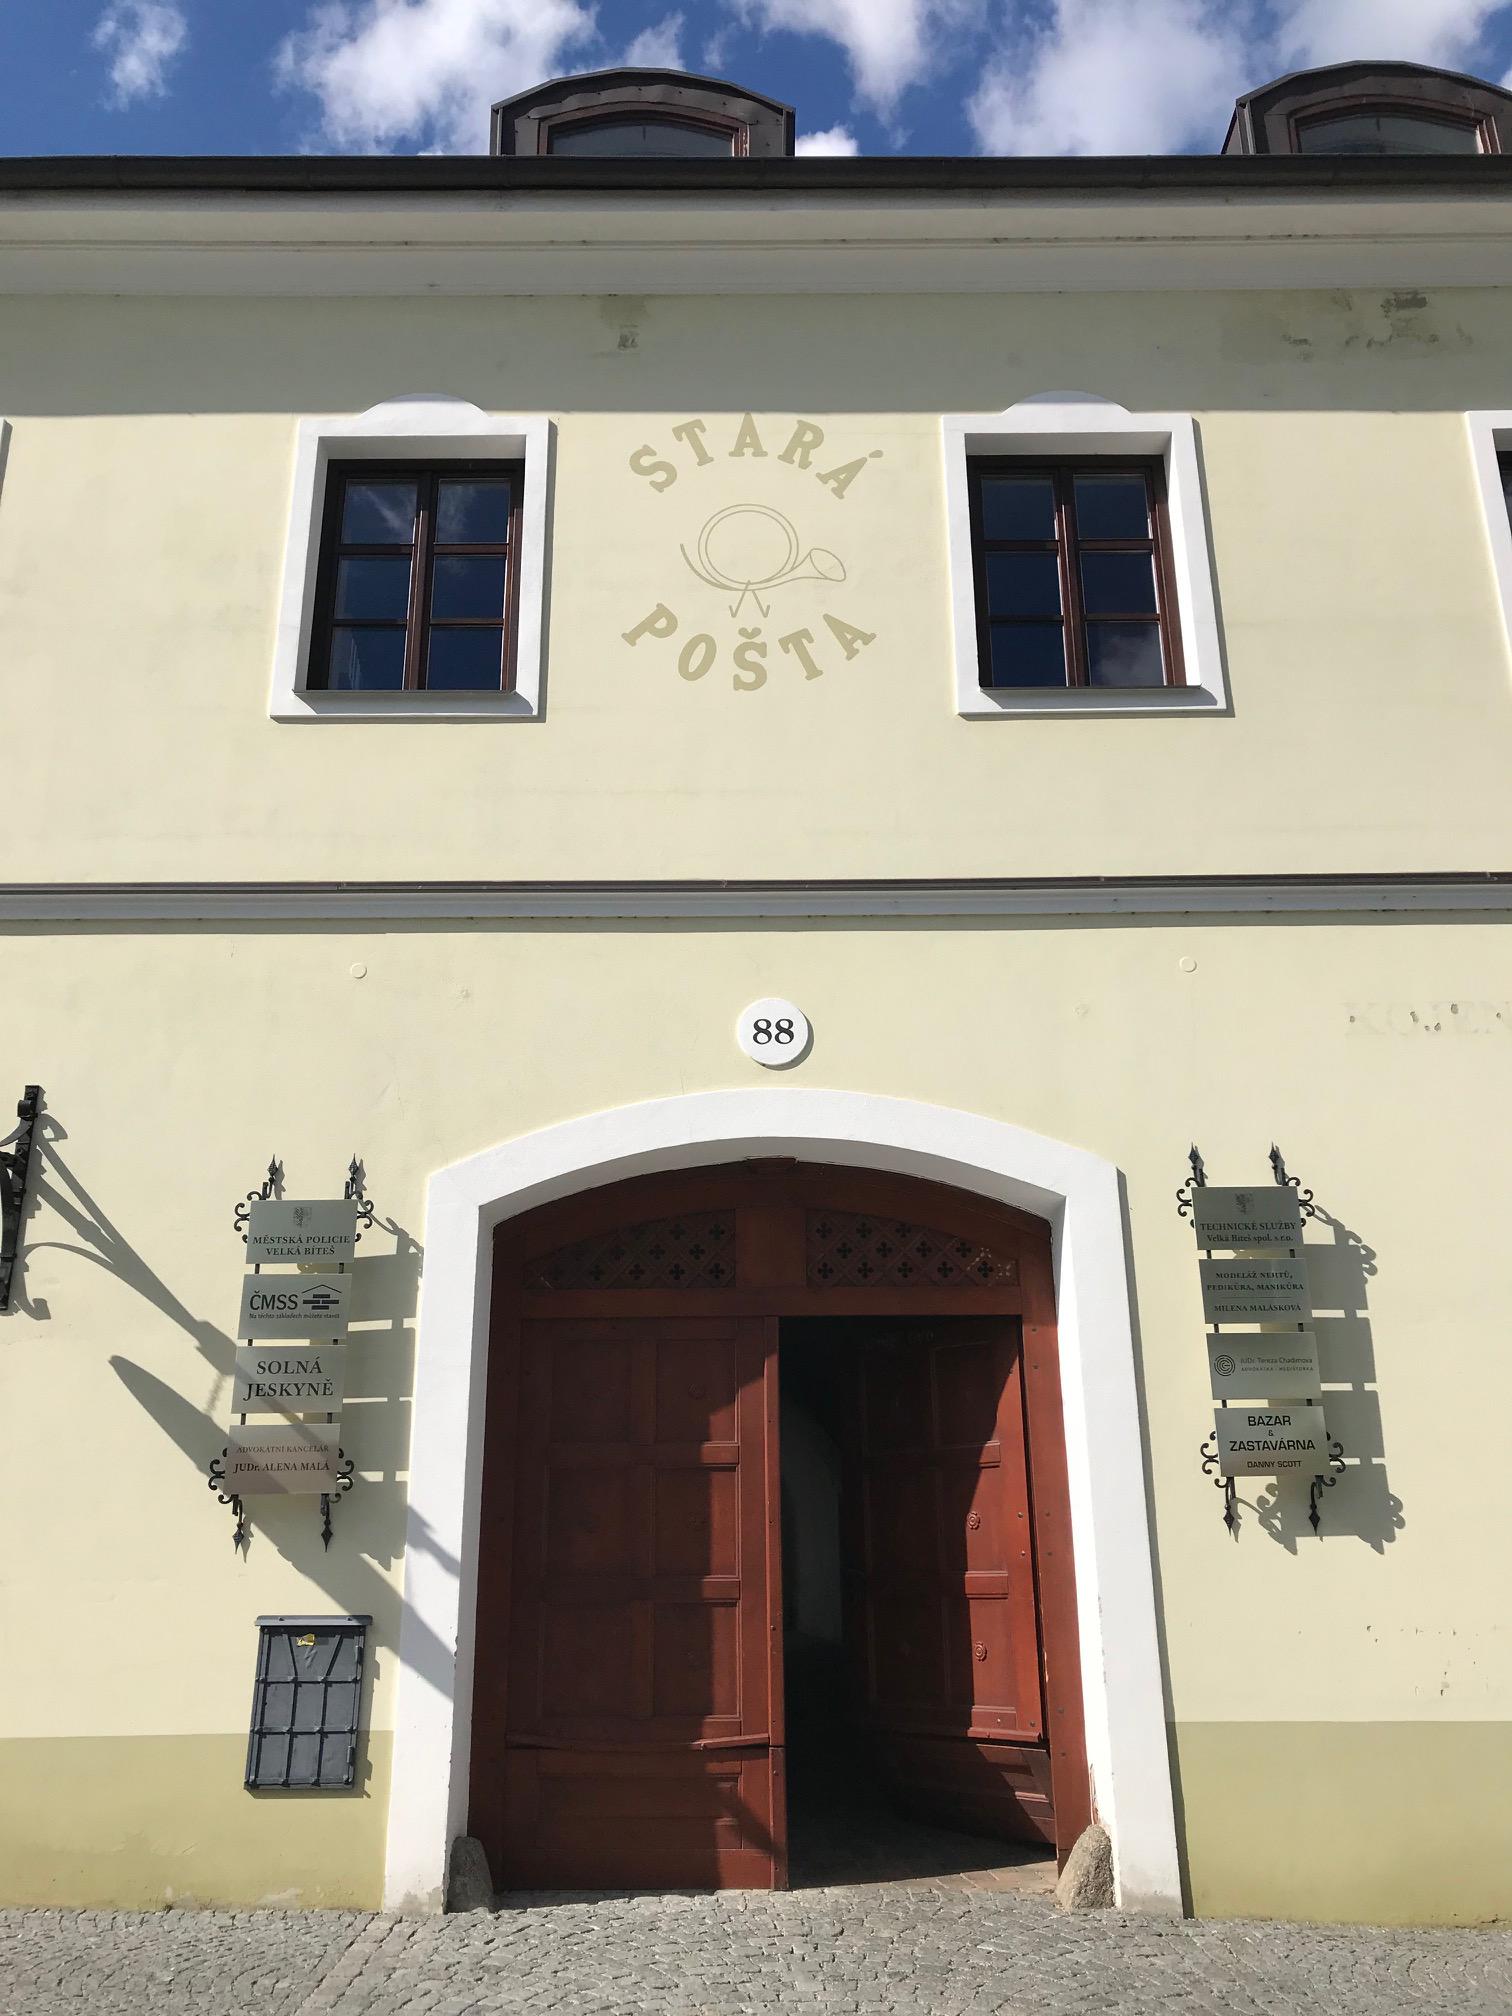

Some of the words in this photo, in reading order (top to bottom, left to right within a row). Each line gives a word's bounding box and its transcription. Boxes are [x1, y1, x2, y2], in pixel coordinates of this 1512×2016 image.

[629, 411, 884, 500] STARÁ
[621, 602, 877, 691] POŠTA
[752, 1018, 795, 1045] 88
[1200, 1221, 1258, 1231] TECHNICKÉ
[1260, 1220, 1296, 1230] SLUŽBY
[252, 1234, 304, 1245] MĚSTSKÁ
[306, 1235, 351, 1244] POLICIE
[266, 1246, 302, 1256] VELKÁ
[304, 1245, 336, 1256] BÍTEŠ
[1215, 1270, 1258, 1279] MODELÁŽ
[250, 1290, 299, 1311] ČMSS
[1214, 1304, 1248, 1312] MILENA
[256, 1356, 323, 1375] SOLNÁ
[243, 1379, 334, 1401] JESKYNĚ
[1247, 1415, 1292, 1427] BAZAR
[1268, 1429, 1274, 1437] &
[1229, 1437, 1316, 1451] ZASTAVÁRNA
[233, 1463, 260, 1474] JUDr.
[262, 1462, 298, 1471] ALENA
[300, 1460, 330, 1471] MALÁ
[1277, 1460, 1303, 1468] SCOTT
